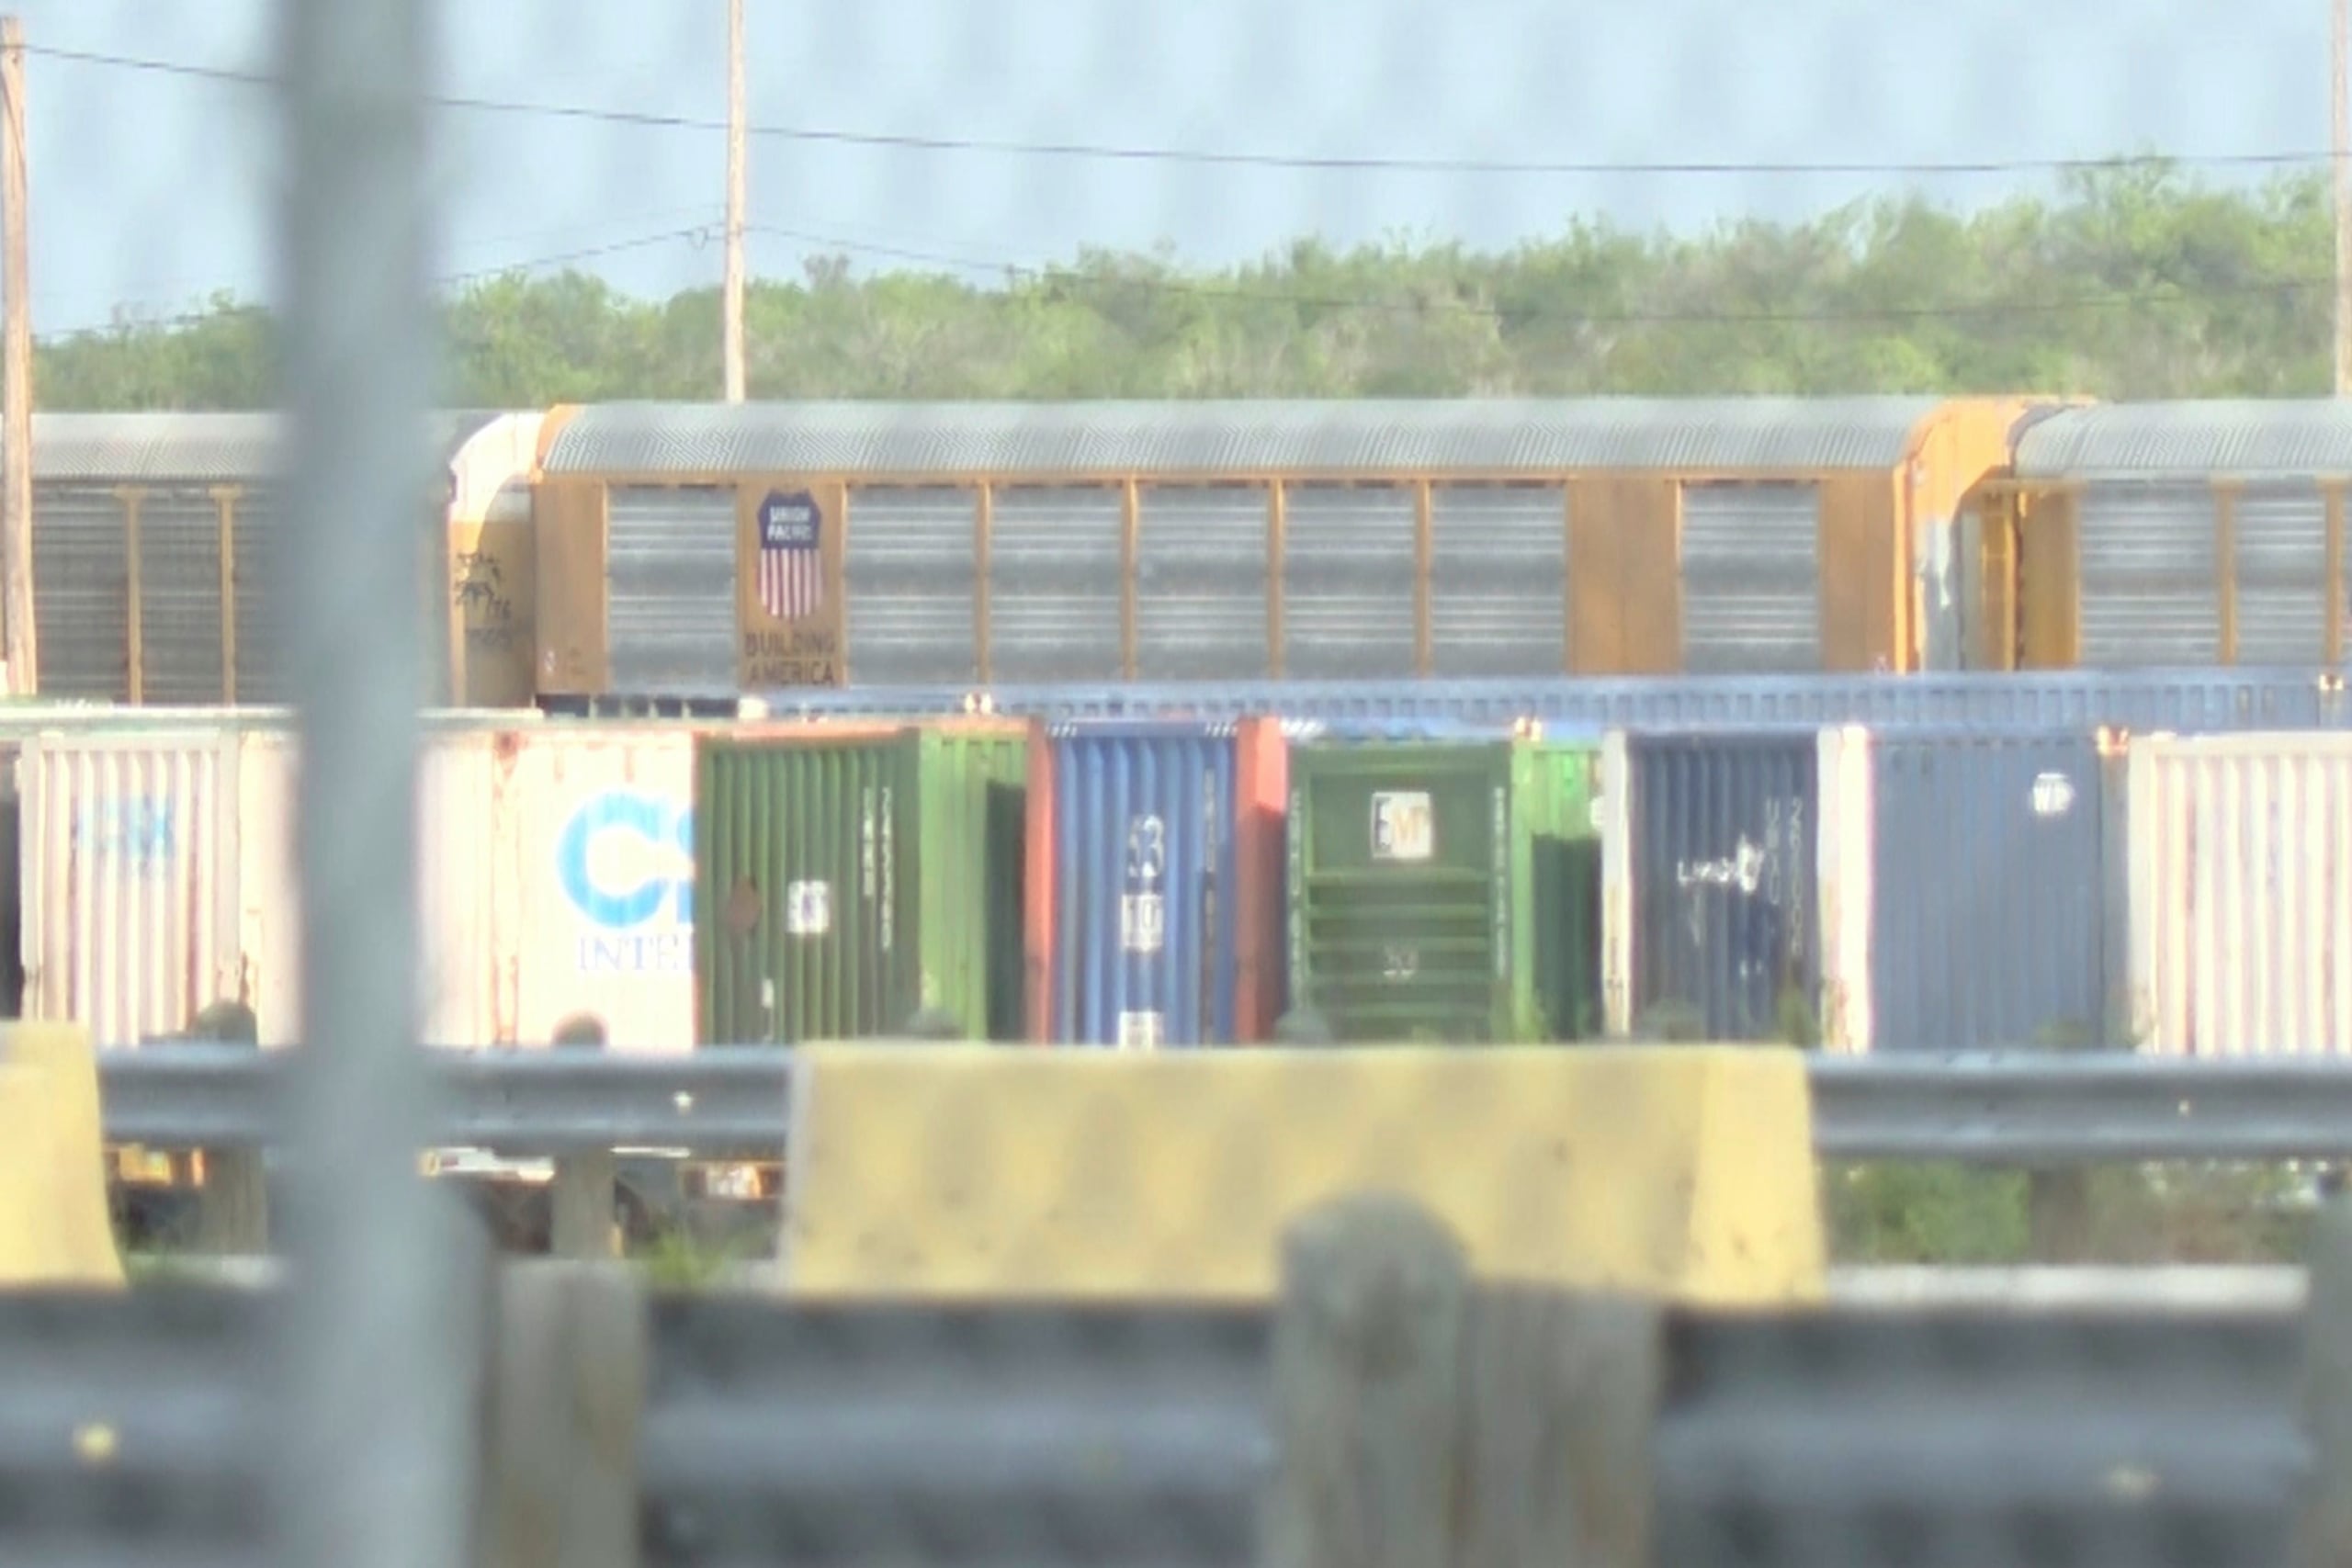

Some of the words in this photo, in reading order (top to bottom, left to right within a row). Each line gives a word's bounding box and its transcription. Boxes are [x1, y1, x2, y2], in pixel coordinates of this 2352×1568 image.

[745, 631, 834, 657] BUILDING
[748, 660, 834, 685] AMERICA
[557, 792, 695, 930] C
[1127, 814, 1164, 877] 53
